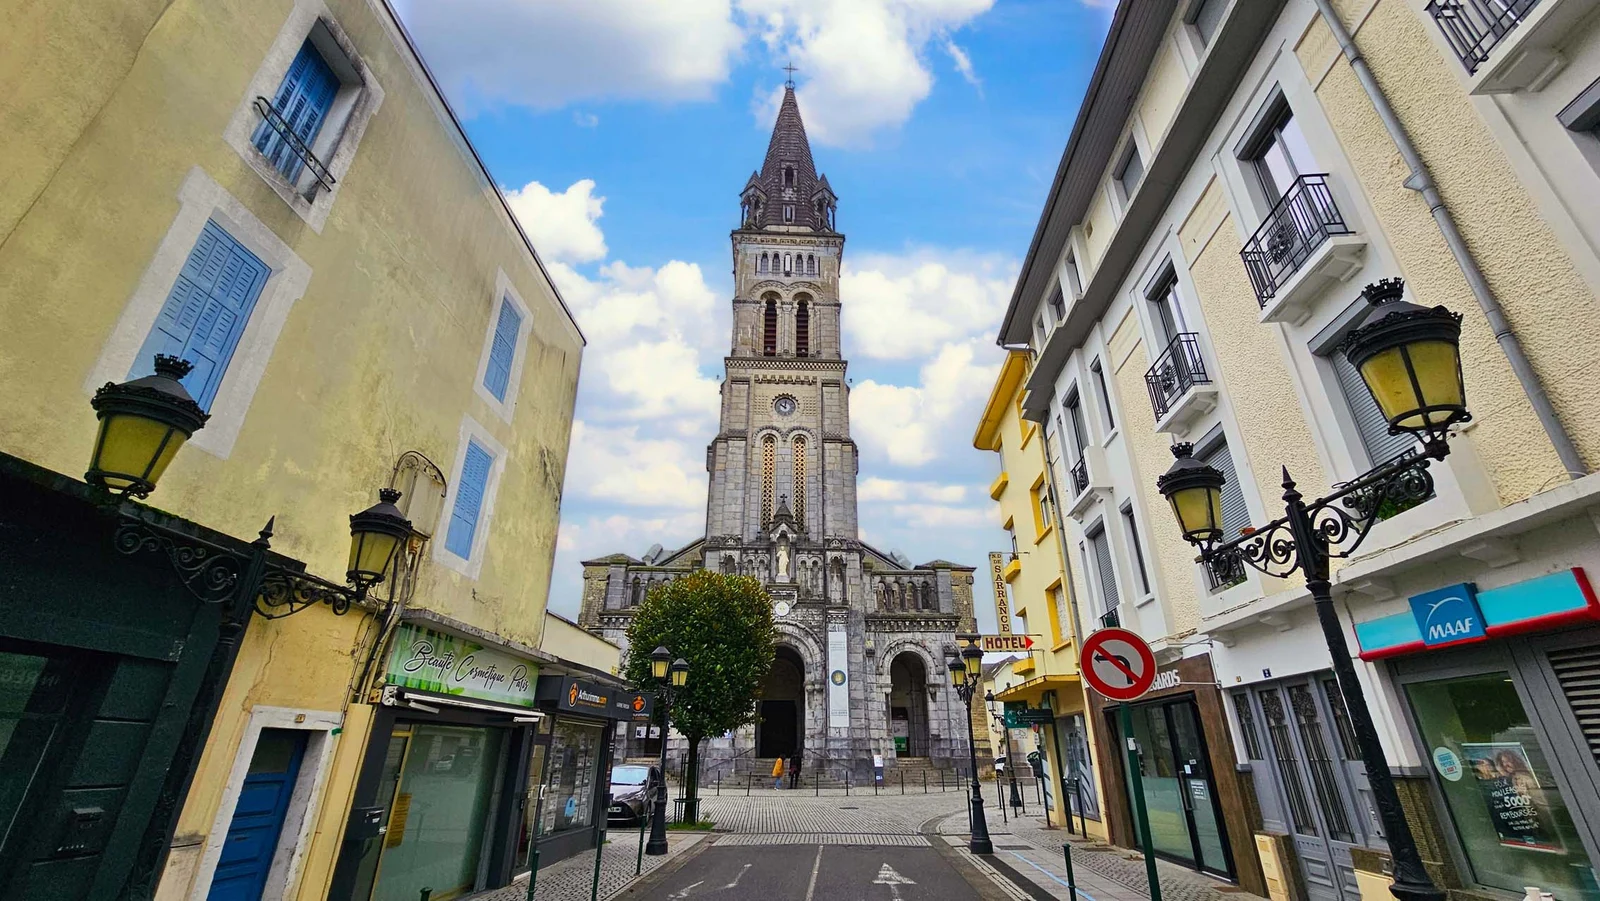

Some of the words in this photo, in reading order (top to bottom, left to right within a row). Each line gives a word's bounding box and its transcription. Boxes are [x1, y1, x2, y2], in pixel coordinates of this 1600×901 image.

[994, 565, 1010, 632] SARRANCE
[985, 636, 1025, 649] HOTEL
[1428, 617, 1473, 640] MAAF
[403, 640, 454, 679] Beauté
[454, 655, 506, 690] Cosmétique
[507, 664, 530, 692] Paris
